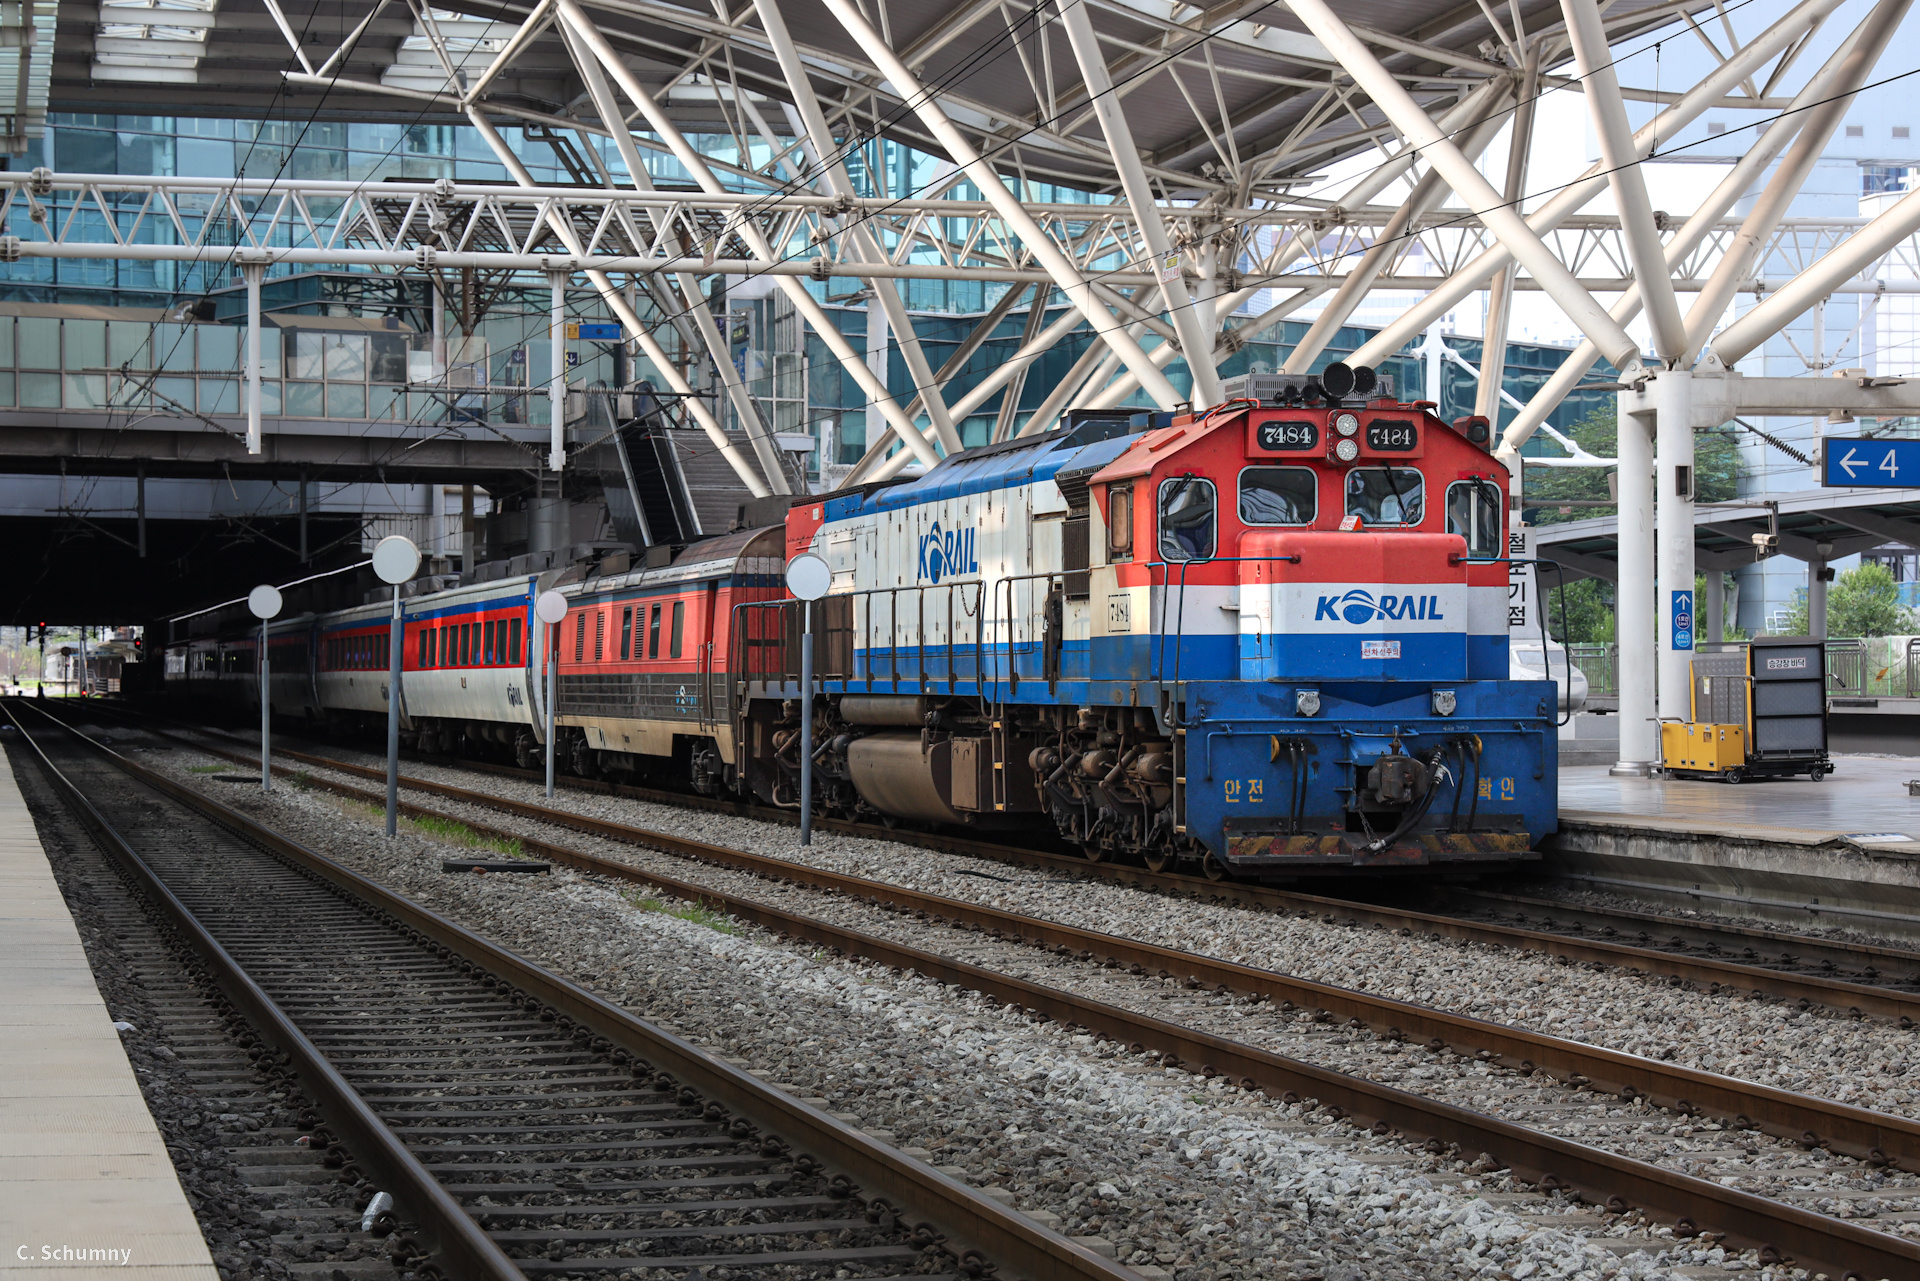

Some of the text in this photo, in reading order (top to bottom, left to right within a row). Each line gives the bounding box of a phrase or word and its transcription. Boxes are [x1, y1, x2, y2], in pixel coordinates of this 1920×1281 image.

[1264, 426, 1312, 444] 7484
[1370, 428, 1411, 446] 7484
[1878, 449, 1899, 479] 4
[918, 521, 978, 585] KORAIL
[1110, 602, 1129, 623] 7484
[1315, 589, 1444, 625] KORAIL
[1769, 658, 1805, 669] 승강장 바닥
